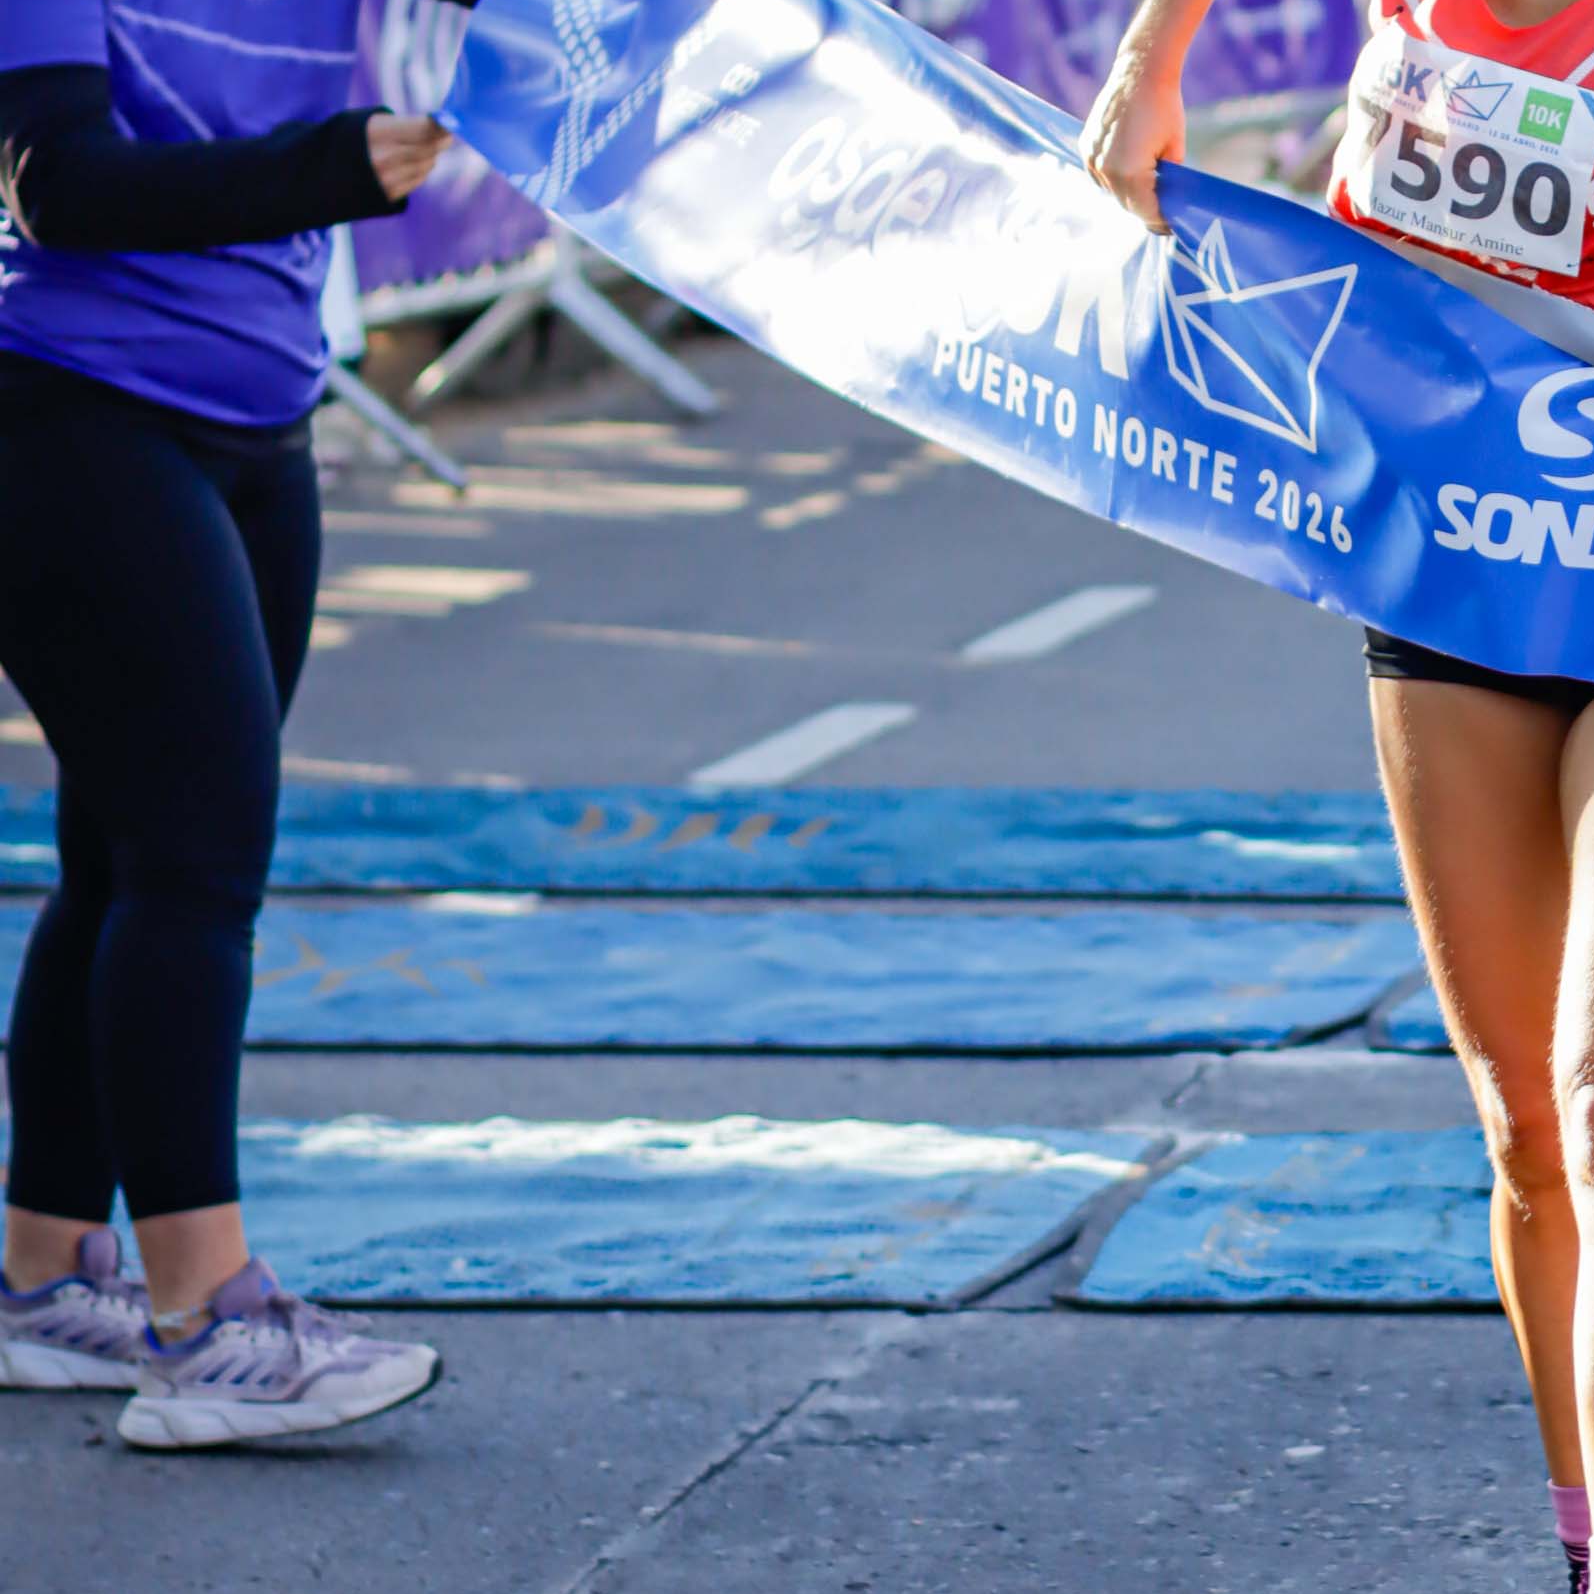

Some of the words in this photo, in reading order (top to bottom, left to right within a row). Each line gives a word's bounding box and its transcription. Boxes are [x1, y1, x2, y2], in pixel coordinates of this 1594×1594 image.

[1527, 103, 1565, 130] 10K
[1357, 96, 1572, 237] 7590
[1410, 212, 1467, 243] Mansur
[1470, 232, 1525, 256] Amine
[932, 337, 1078, 440] PUERTO
[1093, 403, 1238, 504] NORTE
[1255, 468, 1353, 554] 2026
